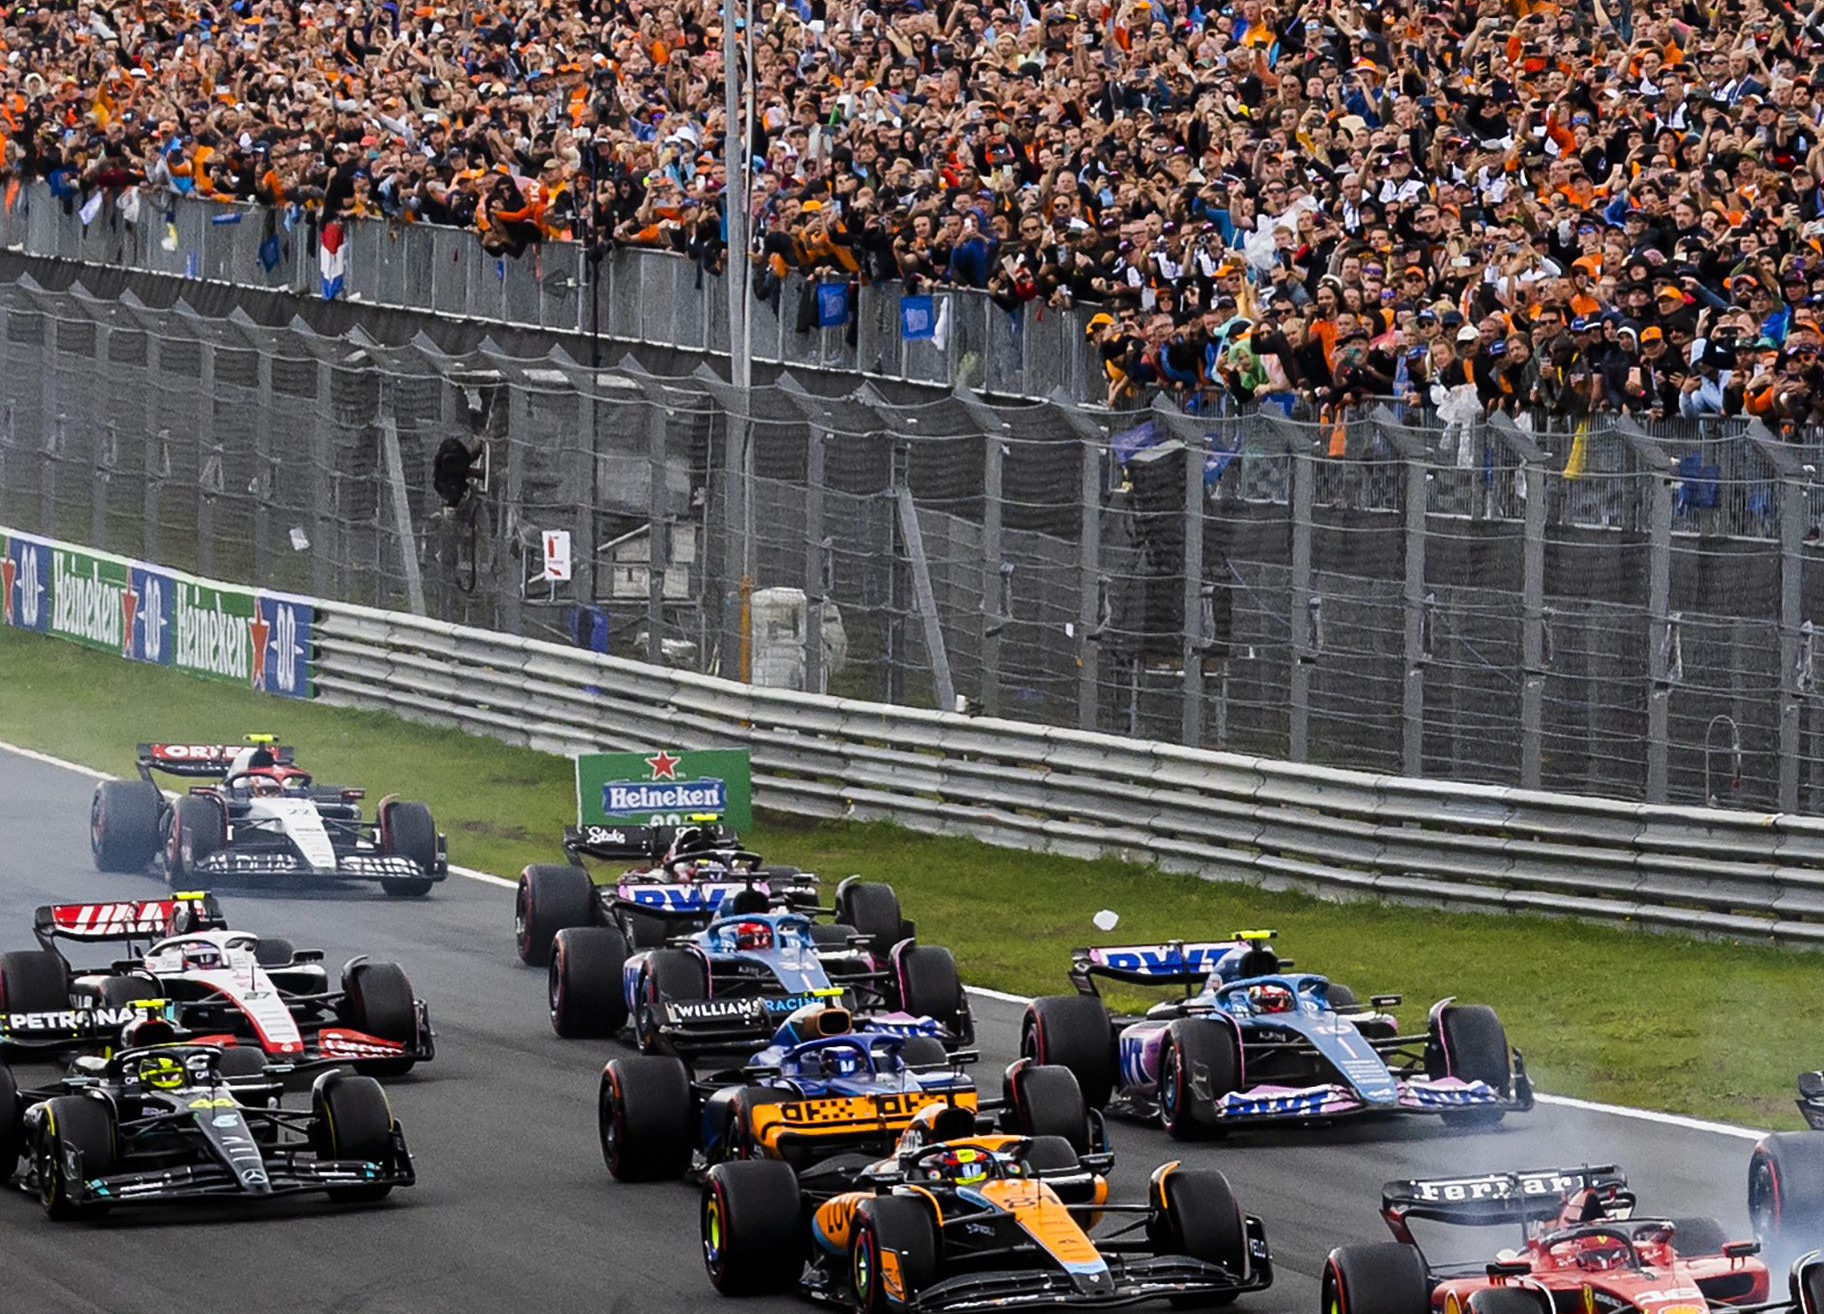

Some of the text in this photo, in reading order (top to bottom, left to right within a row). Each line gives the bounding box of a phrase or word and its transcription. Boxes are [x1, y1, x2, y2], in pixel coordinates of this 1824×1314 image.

[53, 551, 121, 646] Heineken
[176, 584, 248, 679] Heineken
[610, 786, 720, 811] Heineken
[588, 825, 625, 844] Stake
[678, 1000, 760, 1018] WILLIAMS
[188, 1098, 235, 1110] 44
